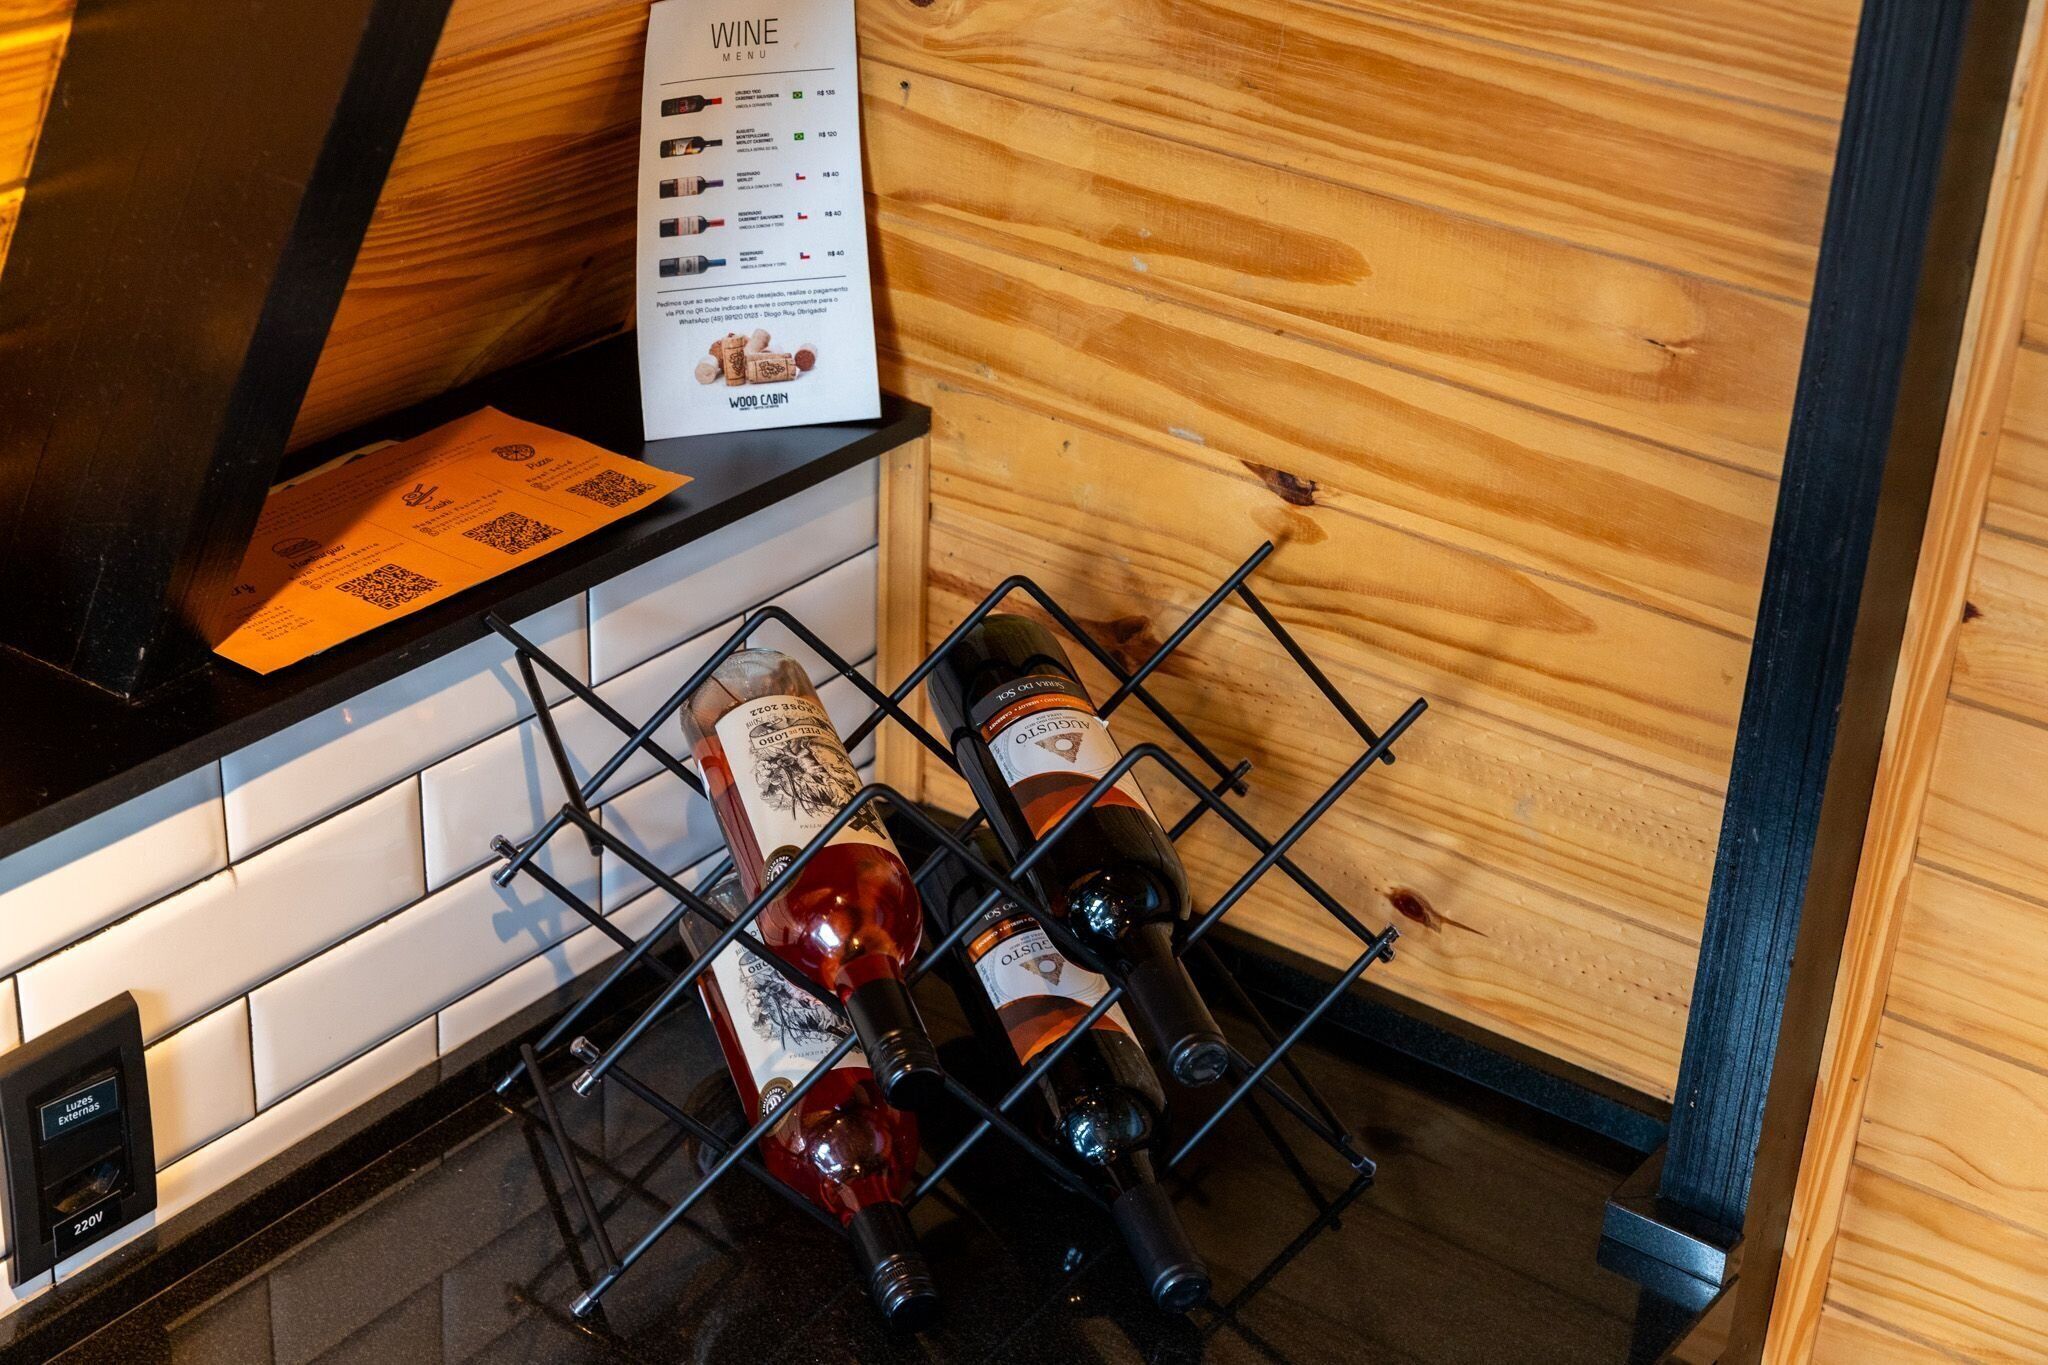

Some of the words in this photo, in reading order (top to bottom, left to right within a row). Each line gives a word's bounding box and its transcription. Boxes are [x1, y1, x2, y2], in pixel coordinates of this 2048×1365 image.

[711, 18, 779, 49] WINE
[723, 51, 766, 62] MENU
[679, 317, 709, 325] WhatsApp
[729, 395, 757, 408] WOOD
[760, 392, 789, 406] CABIN
[1017, 682, 1034, 692] DO
[1035, 681, 1065, 690] SERRA
[750, 704, 779, 716] 2022
[759, 732, 789, 746] LOBO
[799, 727, 822, 736] PIEL
[1016, 720, 1090, 744] AUGUSTO
[1001, 940, 1053, 966] GUSTO
[66, 1095, 93, 1112] Luzes
[58, 1102, 100, 1126] Externas
[74, 1211, 104, 1236] 220V
